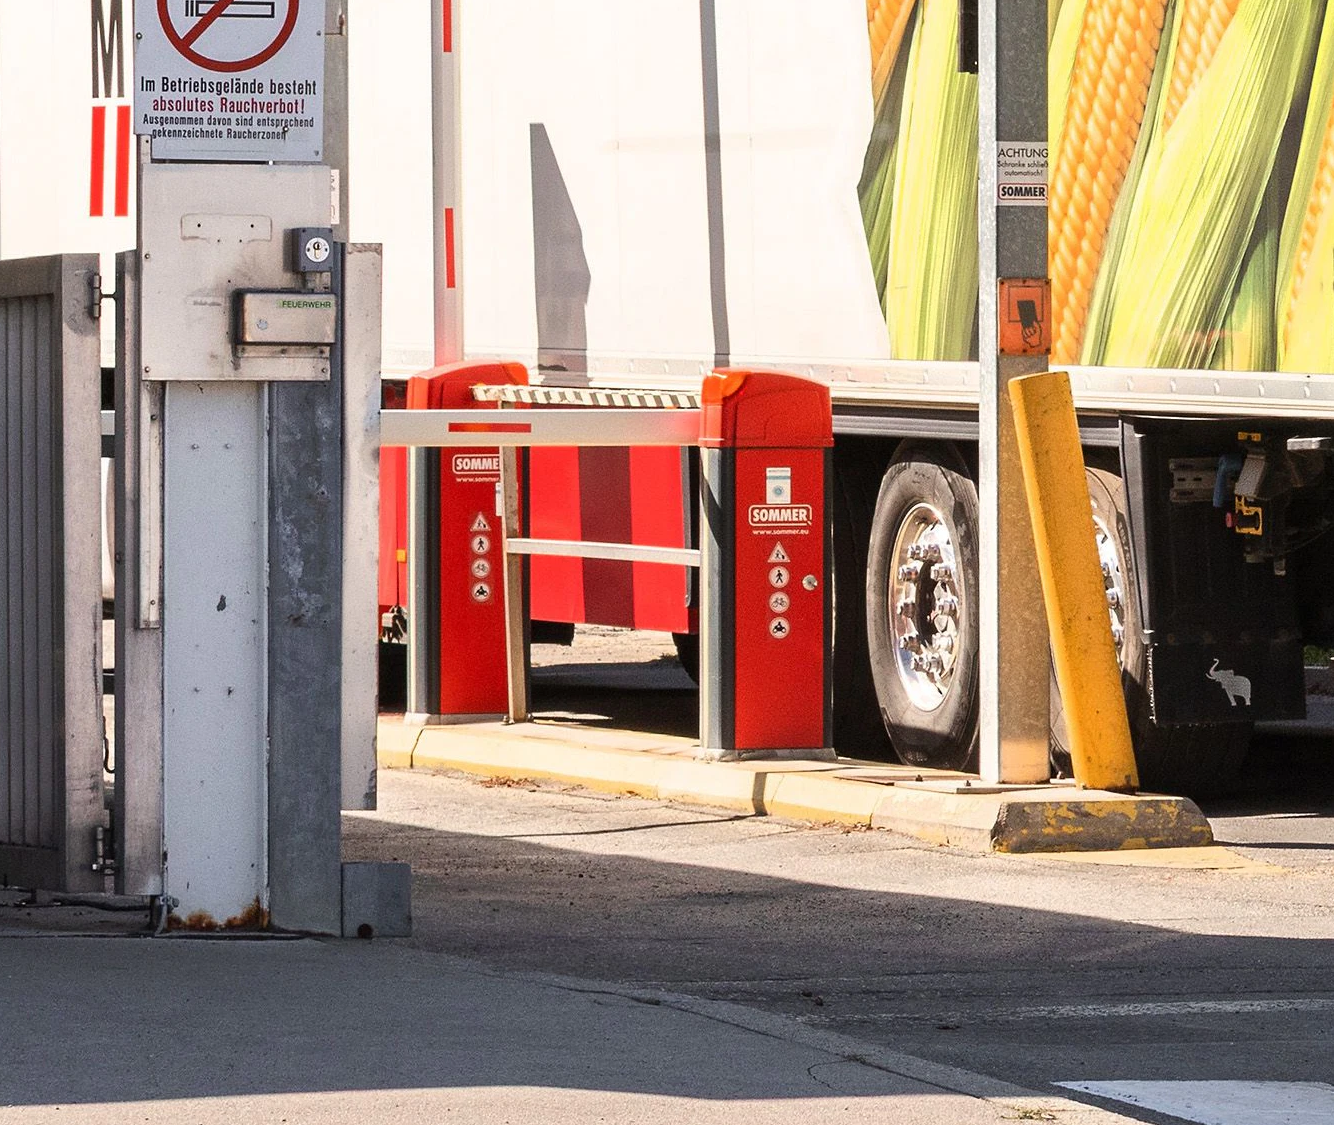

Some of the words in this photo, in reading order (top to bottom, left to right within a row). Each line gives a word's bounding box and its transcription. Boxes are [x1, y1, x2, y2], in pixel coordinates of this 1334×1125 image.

[141, 76, 155, 92] Im
[162, 77, 264, 96] Betriebsgelände
[270, 79, 316, 95] besteht
[153, 97, 213, 112] absolutes
[221, 98, 305, 114] Rauchverbot!
[143, 114, 204, 127] Ausgenommen
[207, 116, 232, 126] davon
[236, 116, 253, 126] sind
[257, 117, 314, 128] entsprechend
[152, 128, 223, 139] gekennzeichnete
[1001, 187, 1045, 196] SOMMER
[456, 458, 499, 470] SOMME
[753, 509, 807, 521] SOMMER
